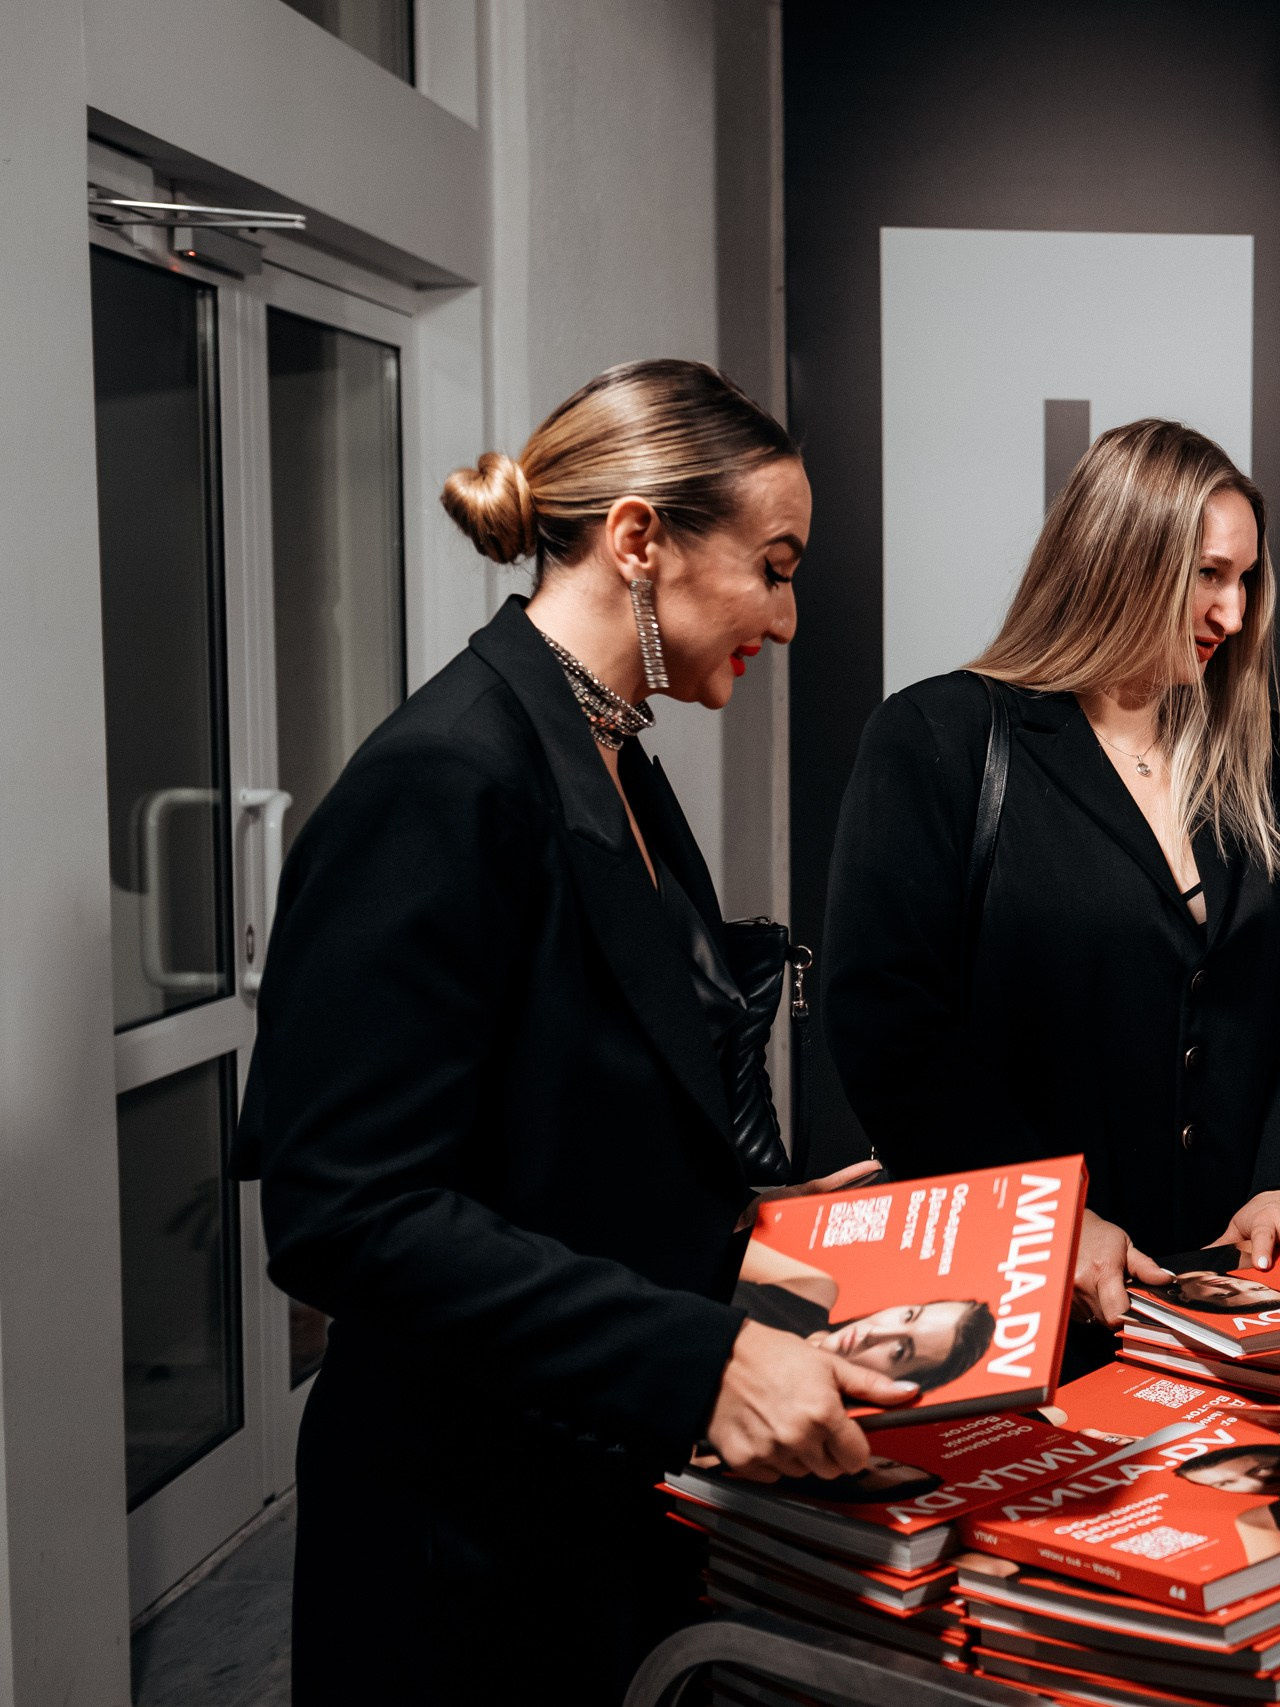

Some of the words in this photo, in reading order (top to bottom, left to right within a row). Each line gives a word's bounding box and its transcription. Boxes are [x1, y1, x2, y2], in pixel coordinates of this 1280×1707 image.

[900, 1189, 926, 1250] Восток
[919, 1187, 947, 1260] Дальний
[937, 1183, 970, 1276] Объединяя
[987, 1174, 1061, 1378] ЛИЦА.DV
[941, 1425, 1034, 1460] Объединяя
[943, 1415, 1002, 1439] Восток
[943, 1419, 1017, 1448] Дальний
[886, 1440, 1098, 1524] ЛИЦА.DV
[1001, 1427, 1236, 1522] ЛИЦА.DV
[1054, 1493, 1169, 1535] Объединяя
[1070, 1504, 1163, 1541] Дальний
[1084, 1515, 1164, 1544] Восток
